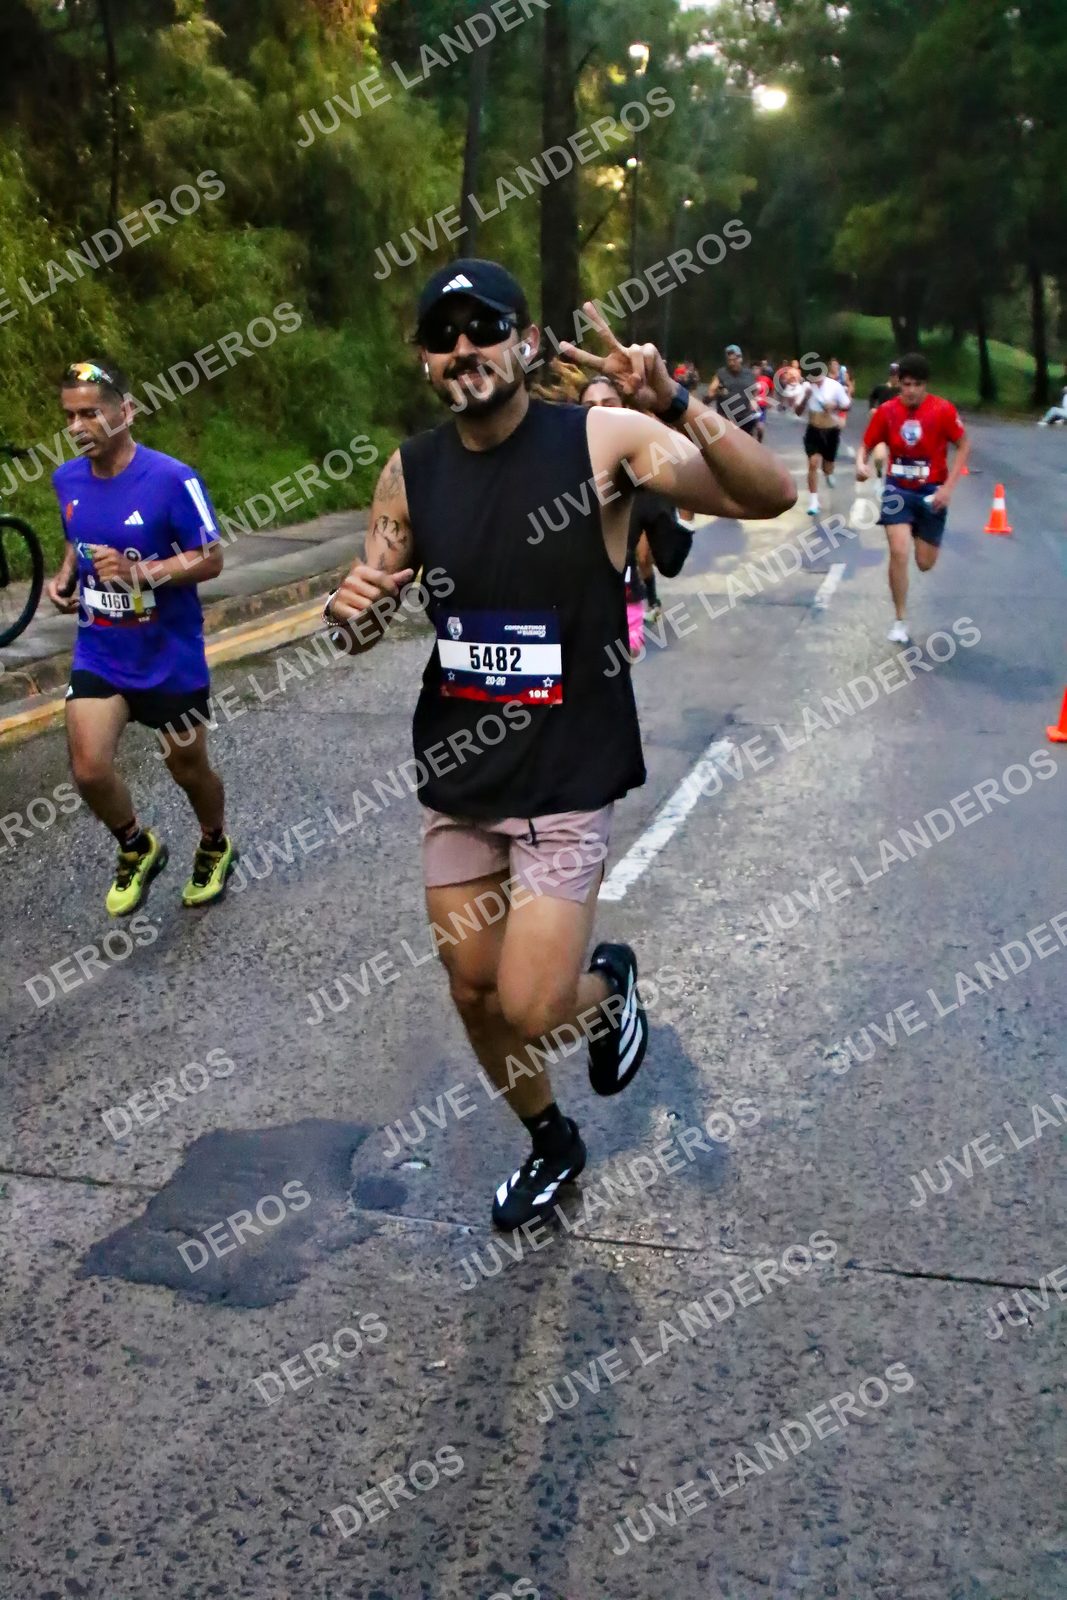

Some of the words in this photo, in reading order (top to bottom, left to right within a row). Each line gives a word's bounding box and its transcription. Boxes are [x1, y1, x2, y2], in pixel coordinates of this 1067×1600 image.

[101, 593, 131, 609] 4160
[469, 645, 522, 672] 5482
[528, 689, 549, 699] 10K
